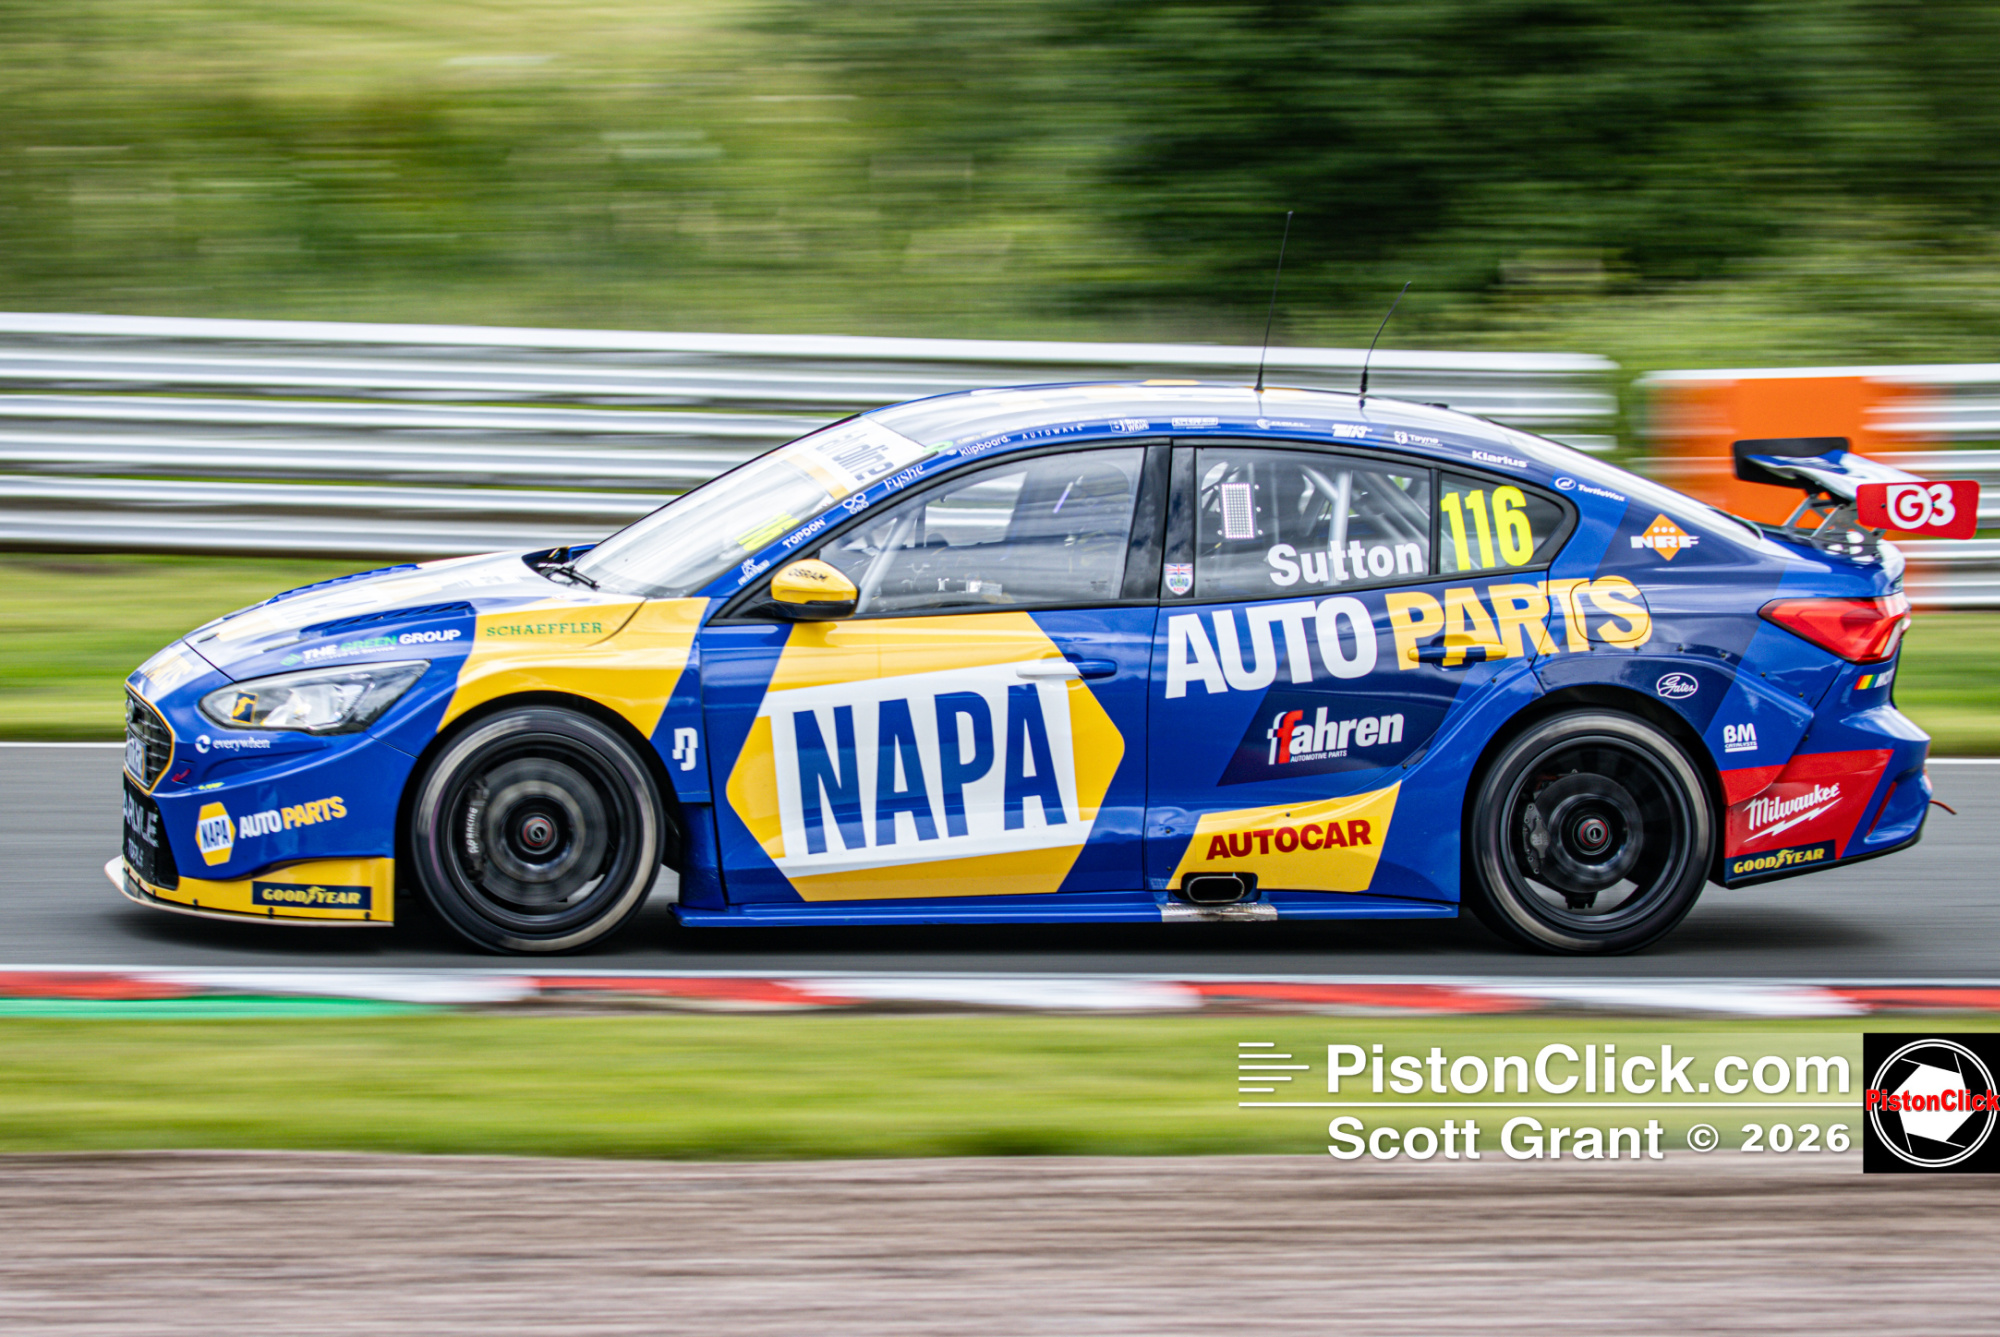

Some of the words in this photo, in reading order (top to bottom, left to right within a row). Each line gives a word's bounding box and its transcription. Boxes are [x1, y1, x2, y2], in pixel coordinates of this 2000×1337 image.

[1472, 450, 1528, 468] Klarius
[882, 464, 926, 490] Fyshe
[1886, 483, 1956, 529] G3
[782, 518, 826, 549] TOPDON
[1441, 485, 1535, 571] 116
[1630, 535, 1700, 549] NRF
[1267, 539, 1424, 587] Sutton
[302, 644, 338, 660] THE
[340, 635, 398, 651] GREEN
[399, 628, 462, 645] GROUP
[486, 622, 603, 637] SCHAEFFLER
[1164, 596, 1378, 700] AUTO
[1385, 575, 1652, 671] PARTS
[1659, 676, 1695, 696] Gates
[213, 737, 271, 751] everywhen
[1267, 706, 1404, 765] fahren
[1723, 722, 1757, 744] BM
[792, 682, 1068, 855] NAPA
[1291, 751, 1327, 763] AUTOMOTIVE
[1328, 750, 1347, 760] PARTS
[1743, 782, 1840, 831] Milwaukee
[201, 818, 231, 850] NAPA
[239, 810, 283, 839] AUTO
[280, 796, 348, 829] PARTS
[1206, 819, 1372, 861] AUTOCAR
[1733, 848, 1825, 874] GOODYEAR
[262, 886, 361, 905] GOODYEAR
